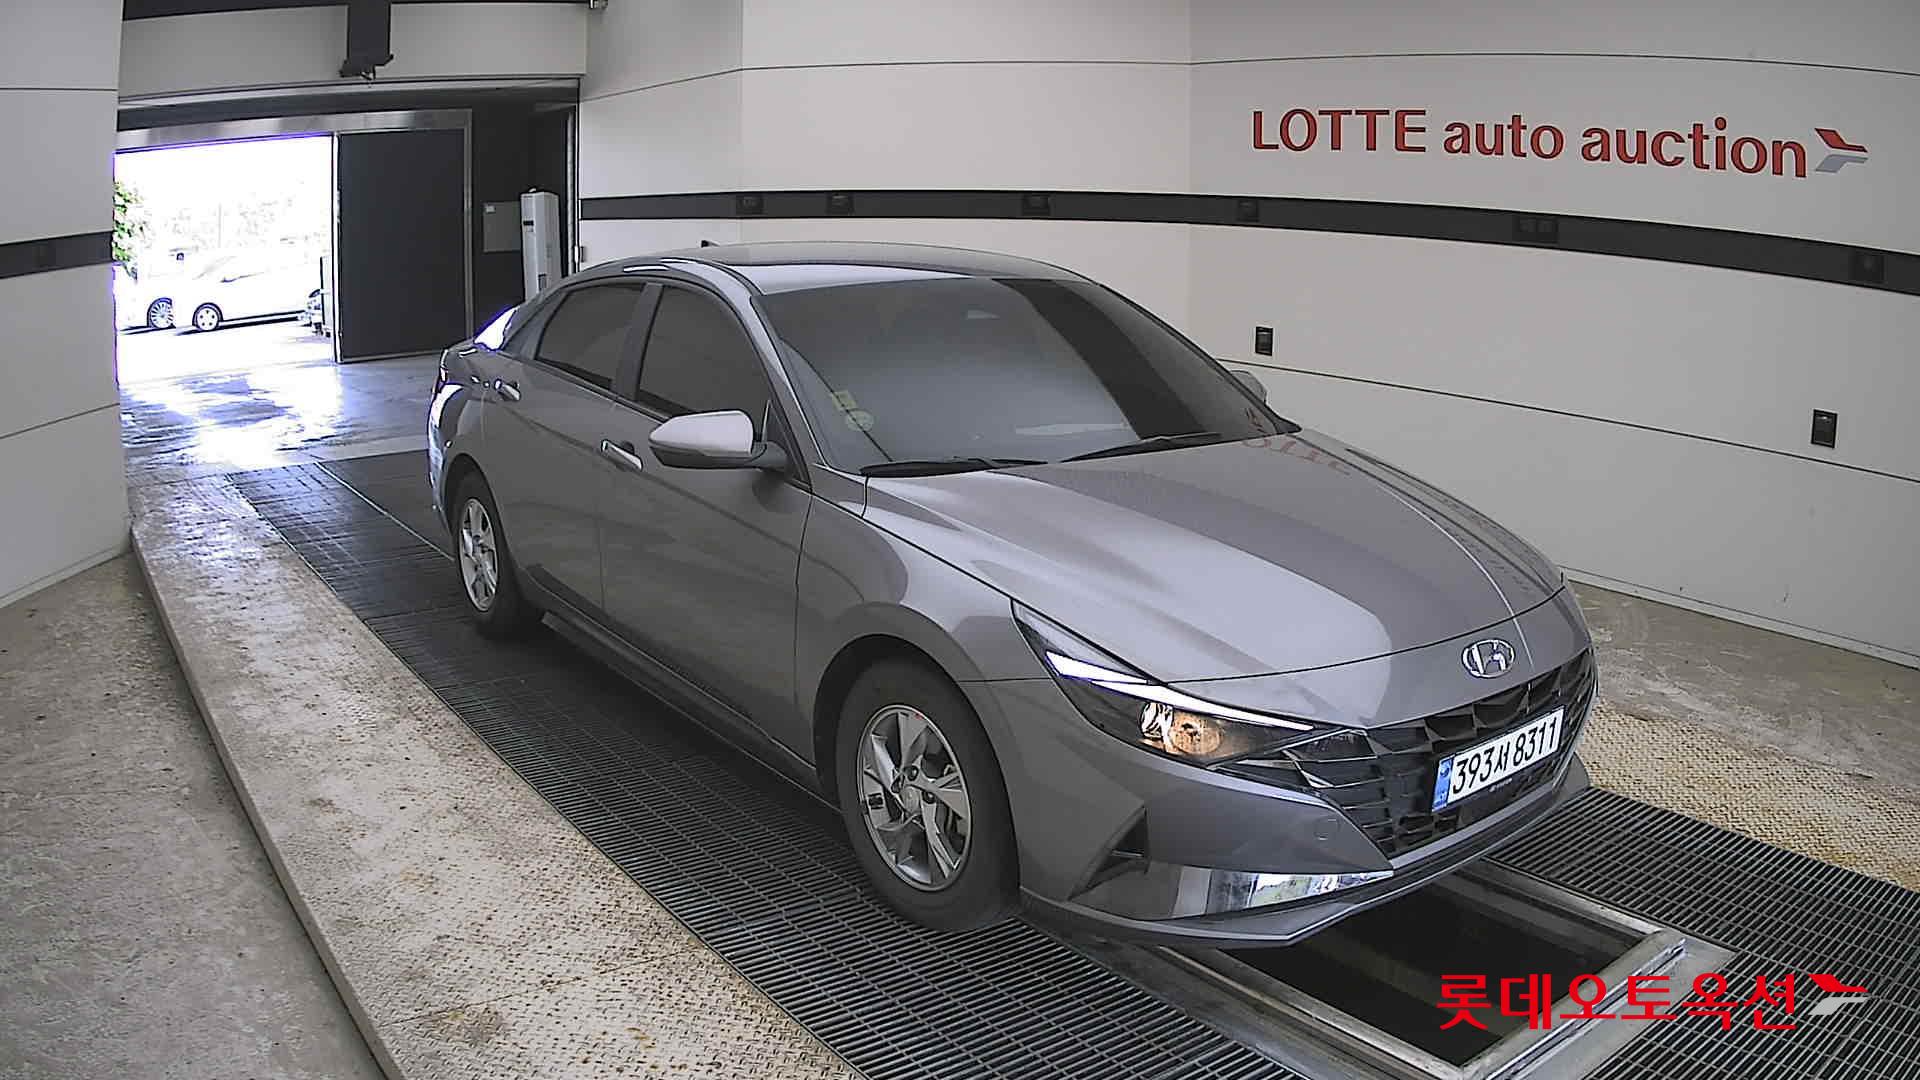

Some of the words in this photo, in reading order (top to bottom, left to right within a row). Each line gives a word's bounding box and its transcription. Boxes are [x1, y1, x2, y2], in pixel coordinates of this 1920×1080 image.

[1253, 109, 1426, 153] LOTTE
[1443, 115, 1565, 159] auto
[1581, 117, 1807, 178] auction
[1513, 717, 1557, 766] 8311
